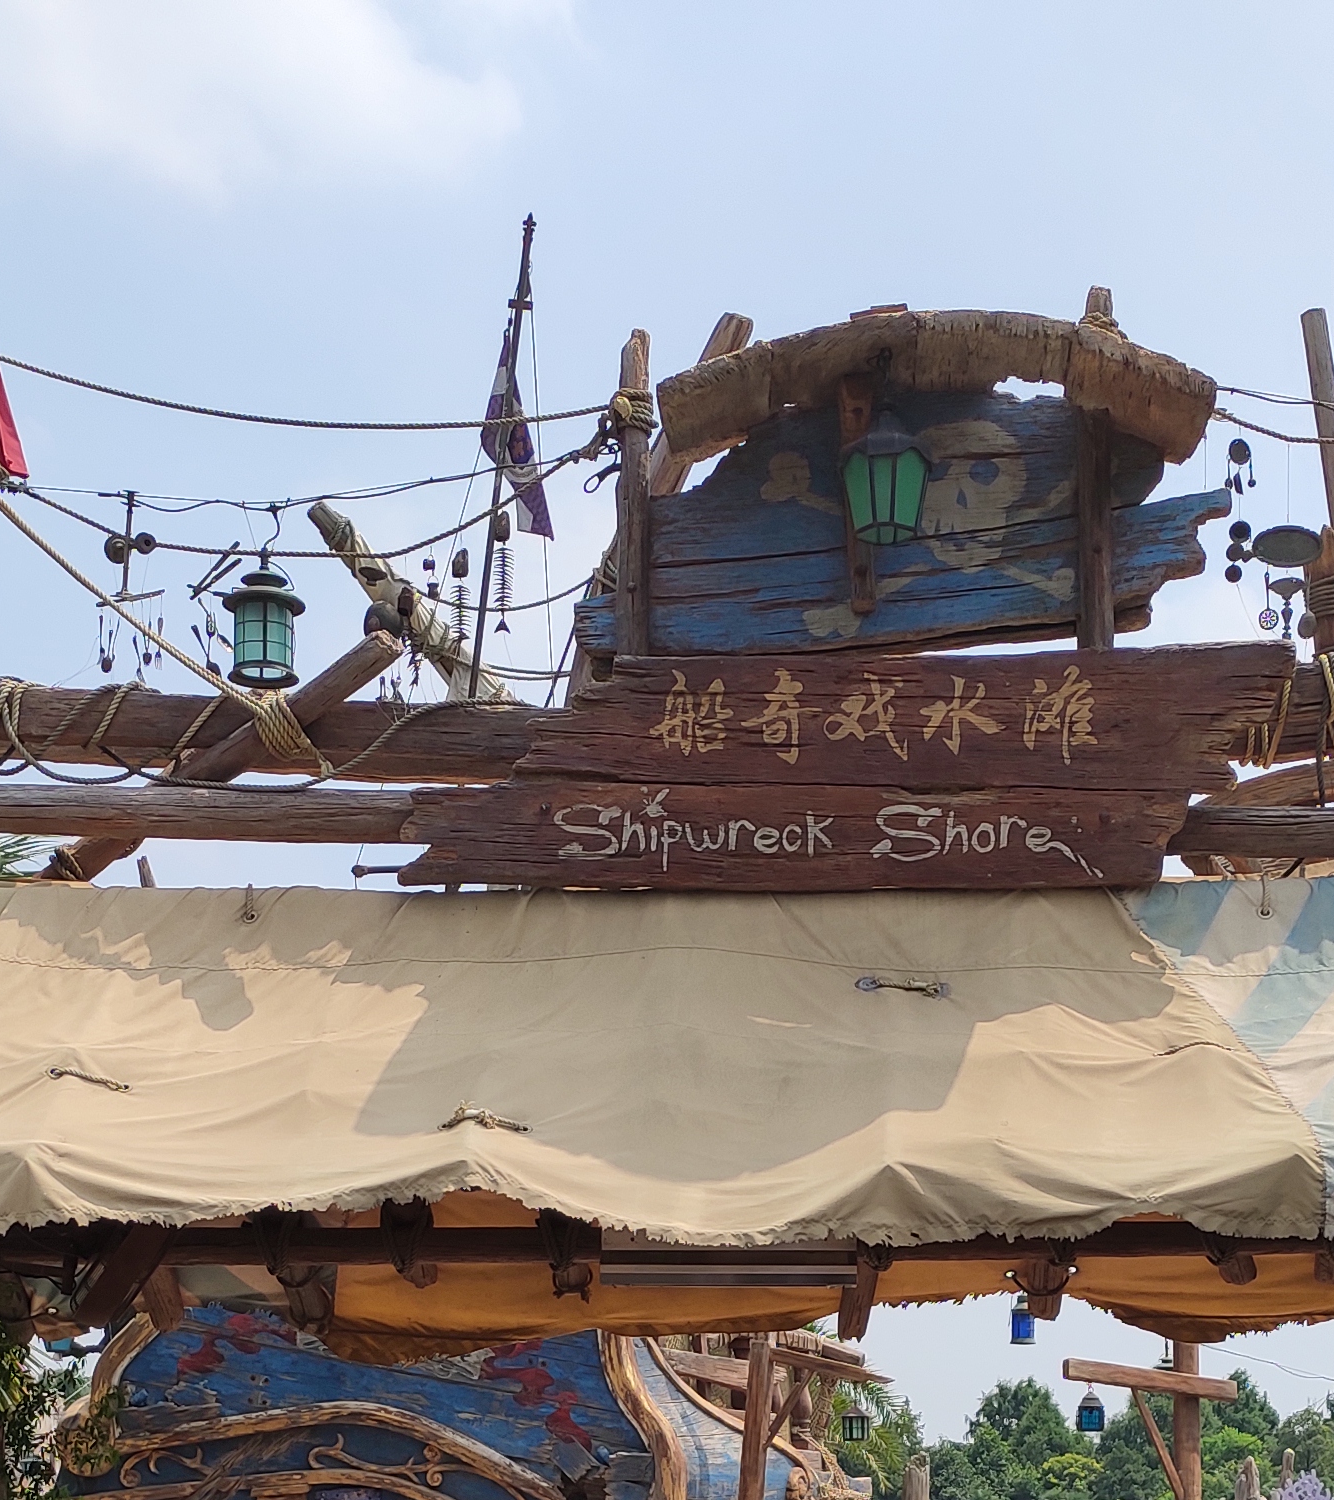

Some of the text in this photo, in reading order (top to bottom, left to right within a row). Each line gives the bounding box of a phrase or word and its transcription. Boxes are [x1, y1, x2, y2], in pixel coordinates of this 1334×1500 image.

[648, 665, 1100, 765] 船奇戏水滩
[553, 787, 1103, 878] Shipwreck Shore
